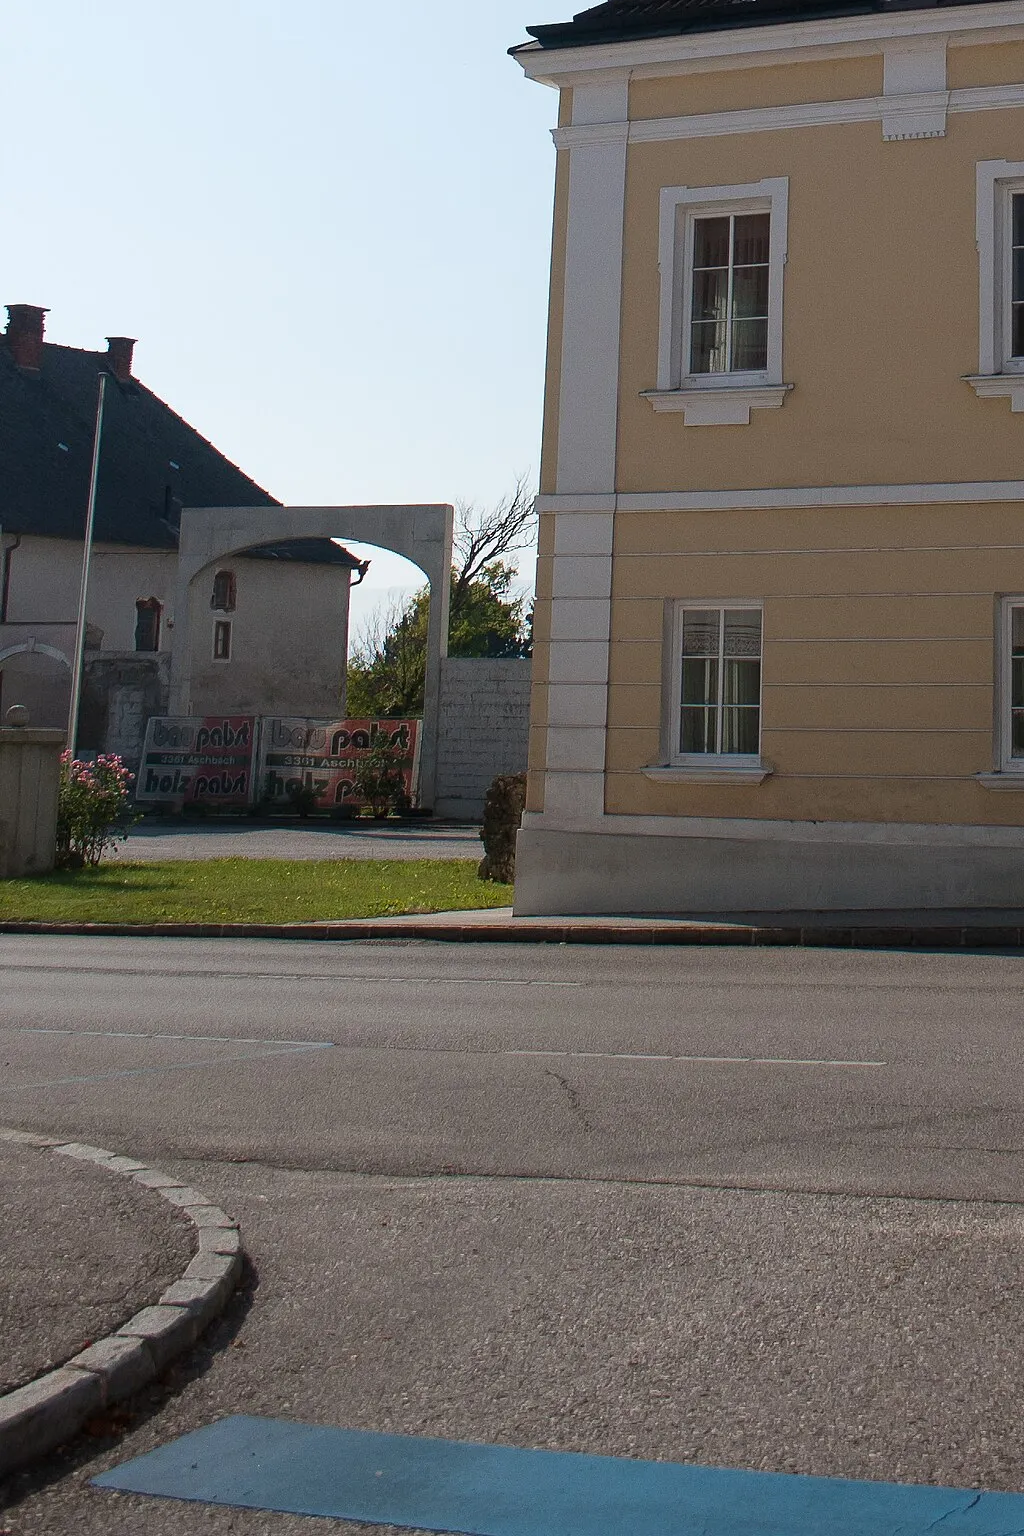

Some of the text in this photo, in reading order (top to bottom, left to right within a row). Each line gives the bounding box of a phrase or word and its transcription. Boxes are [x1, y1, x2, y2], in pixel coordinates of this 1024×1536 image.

[153, 719, 250, 754] bau pabst
[272, 719, 327, 749] bau
[187, 755, 236, 766] Aschbach
[284, 756, 315, 767] 3361
[145, 768, 248, 800] holz pabst
